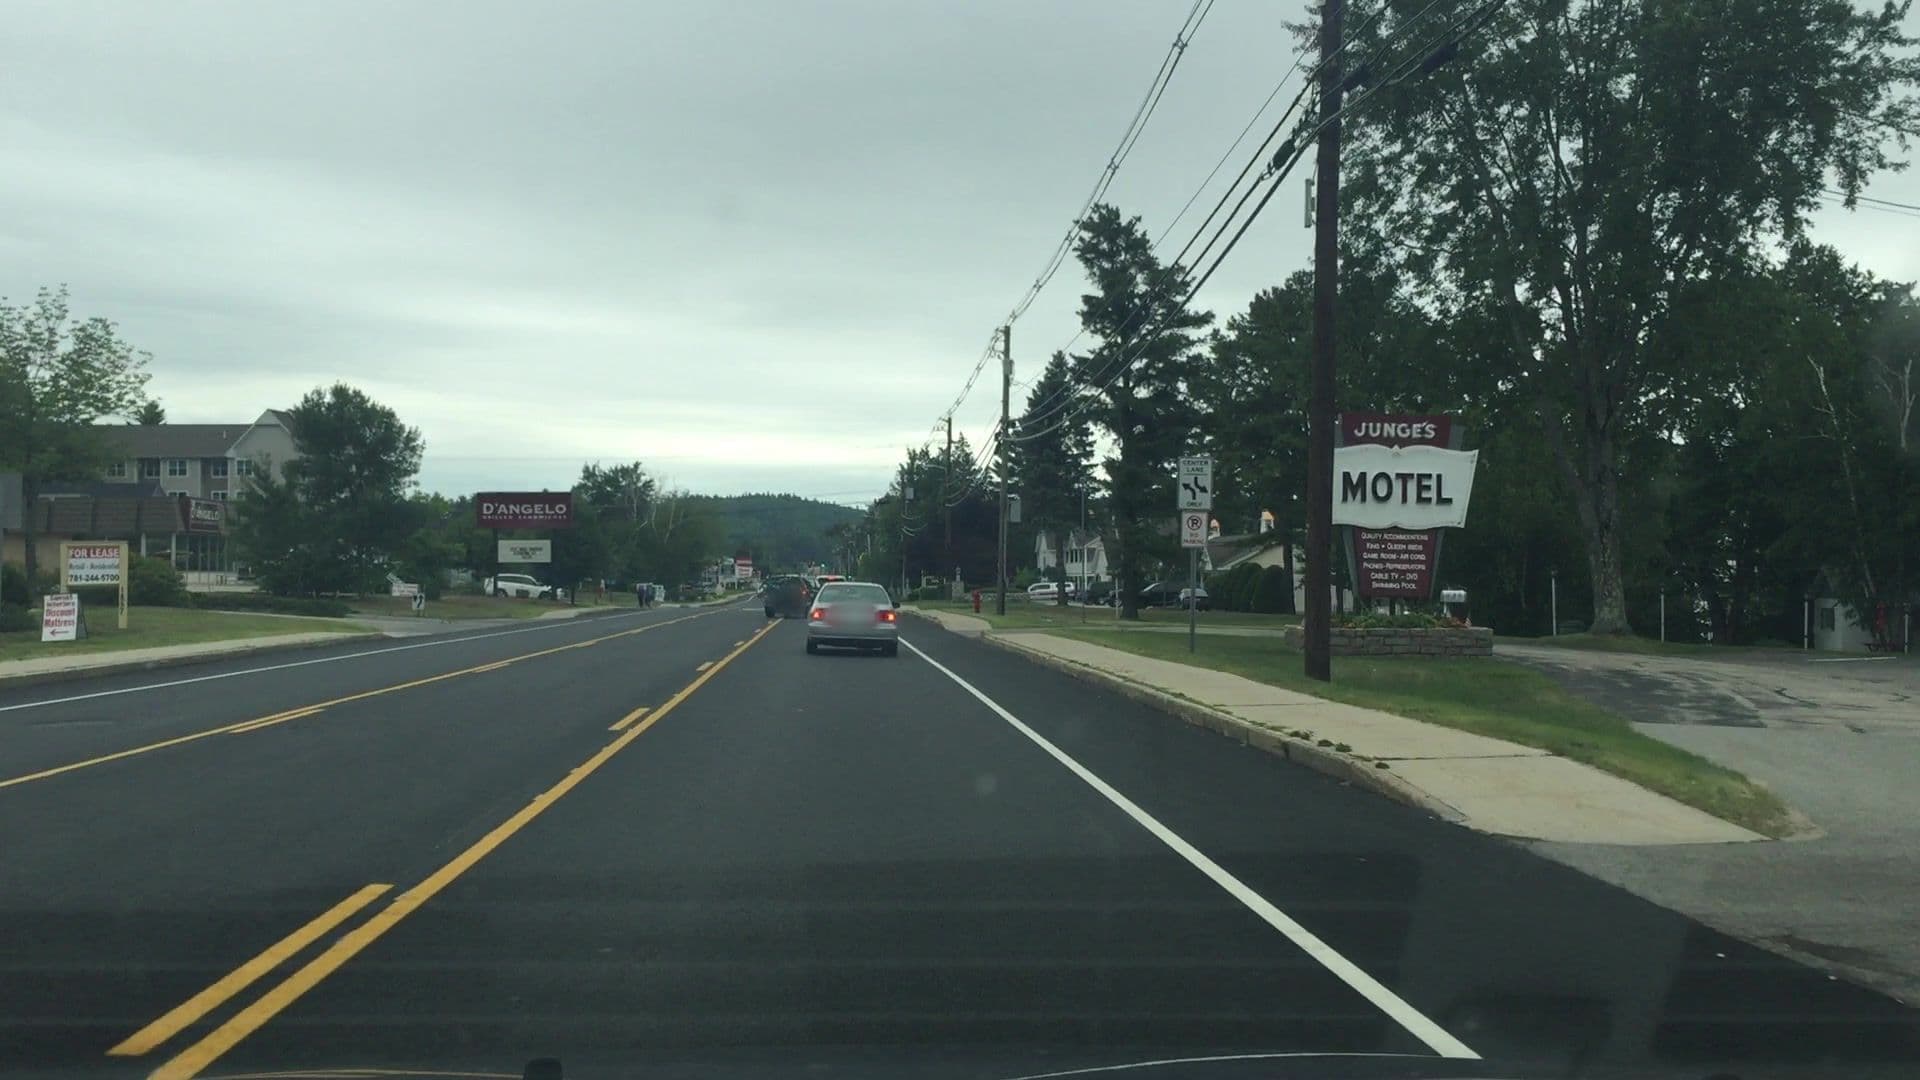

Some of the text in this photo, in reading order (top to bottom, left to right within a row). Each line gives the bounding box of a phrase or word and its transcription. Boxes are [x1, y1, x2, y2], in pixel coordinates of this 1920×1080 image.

[1354, 421, 1437, 440] JUNGE'S
[1341, 471, 1453, 506] MOTEL
[482, 502, 567, 515] D'ANGELO
[69, 547, 120, 558] FOR LEASE
